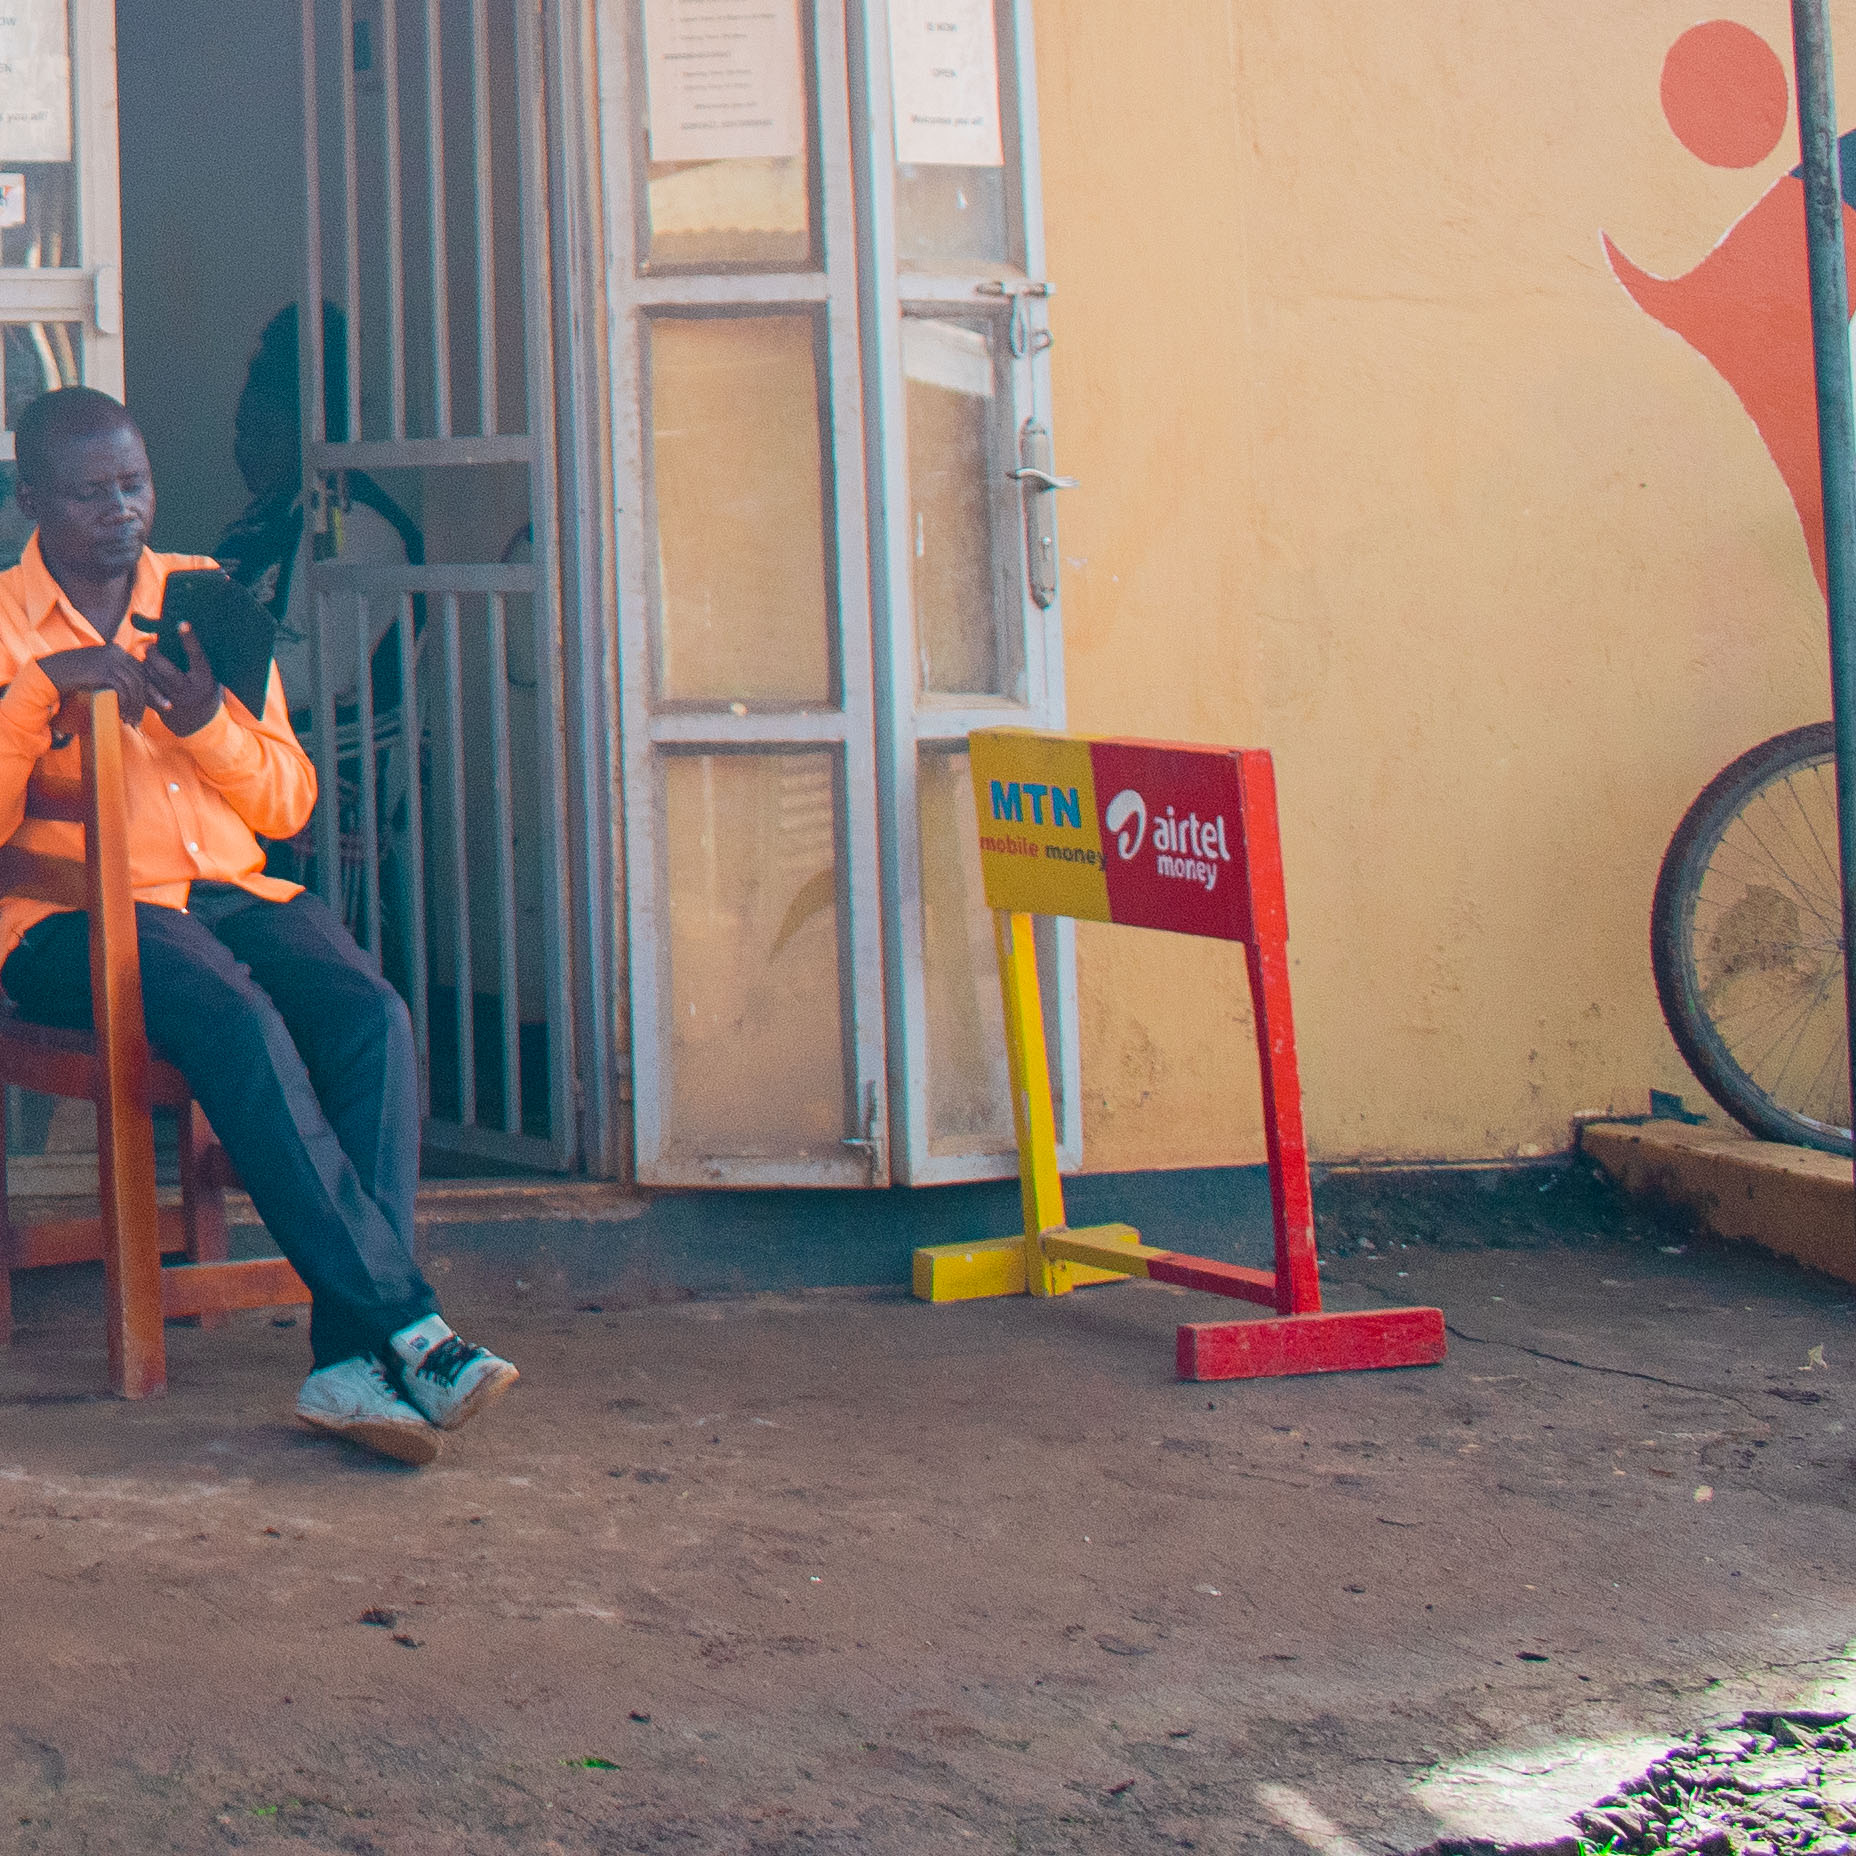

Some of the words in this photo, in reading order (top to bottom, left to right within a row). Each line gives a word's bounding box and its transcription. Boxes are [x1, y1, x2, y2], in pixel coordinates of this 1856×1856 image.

[991, 779, 1083, 829] MTN
[979, 834, 1039, 858] mobile
[1045, 842, 1108, 873] money
[1152, 805, 1232, 862] airtel
[1155, 854, 1218, 891] money
